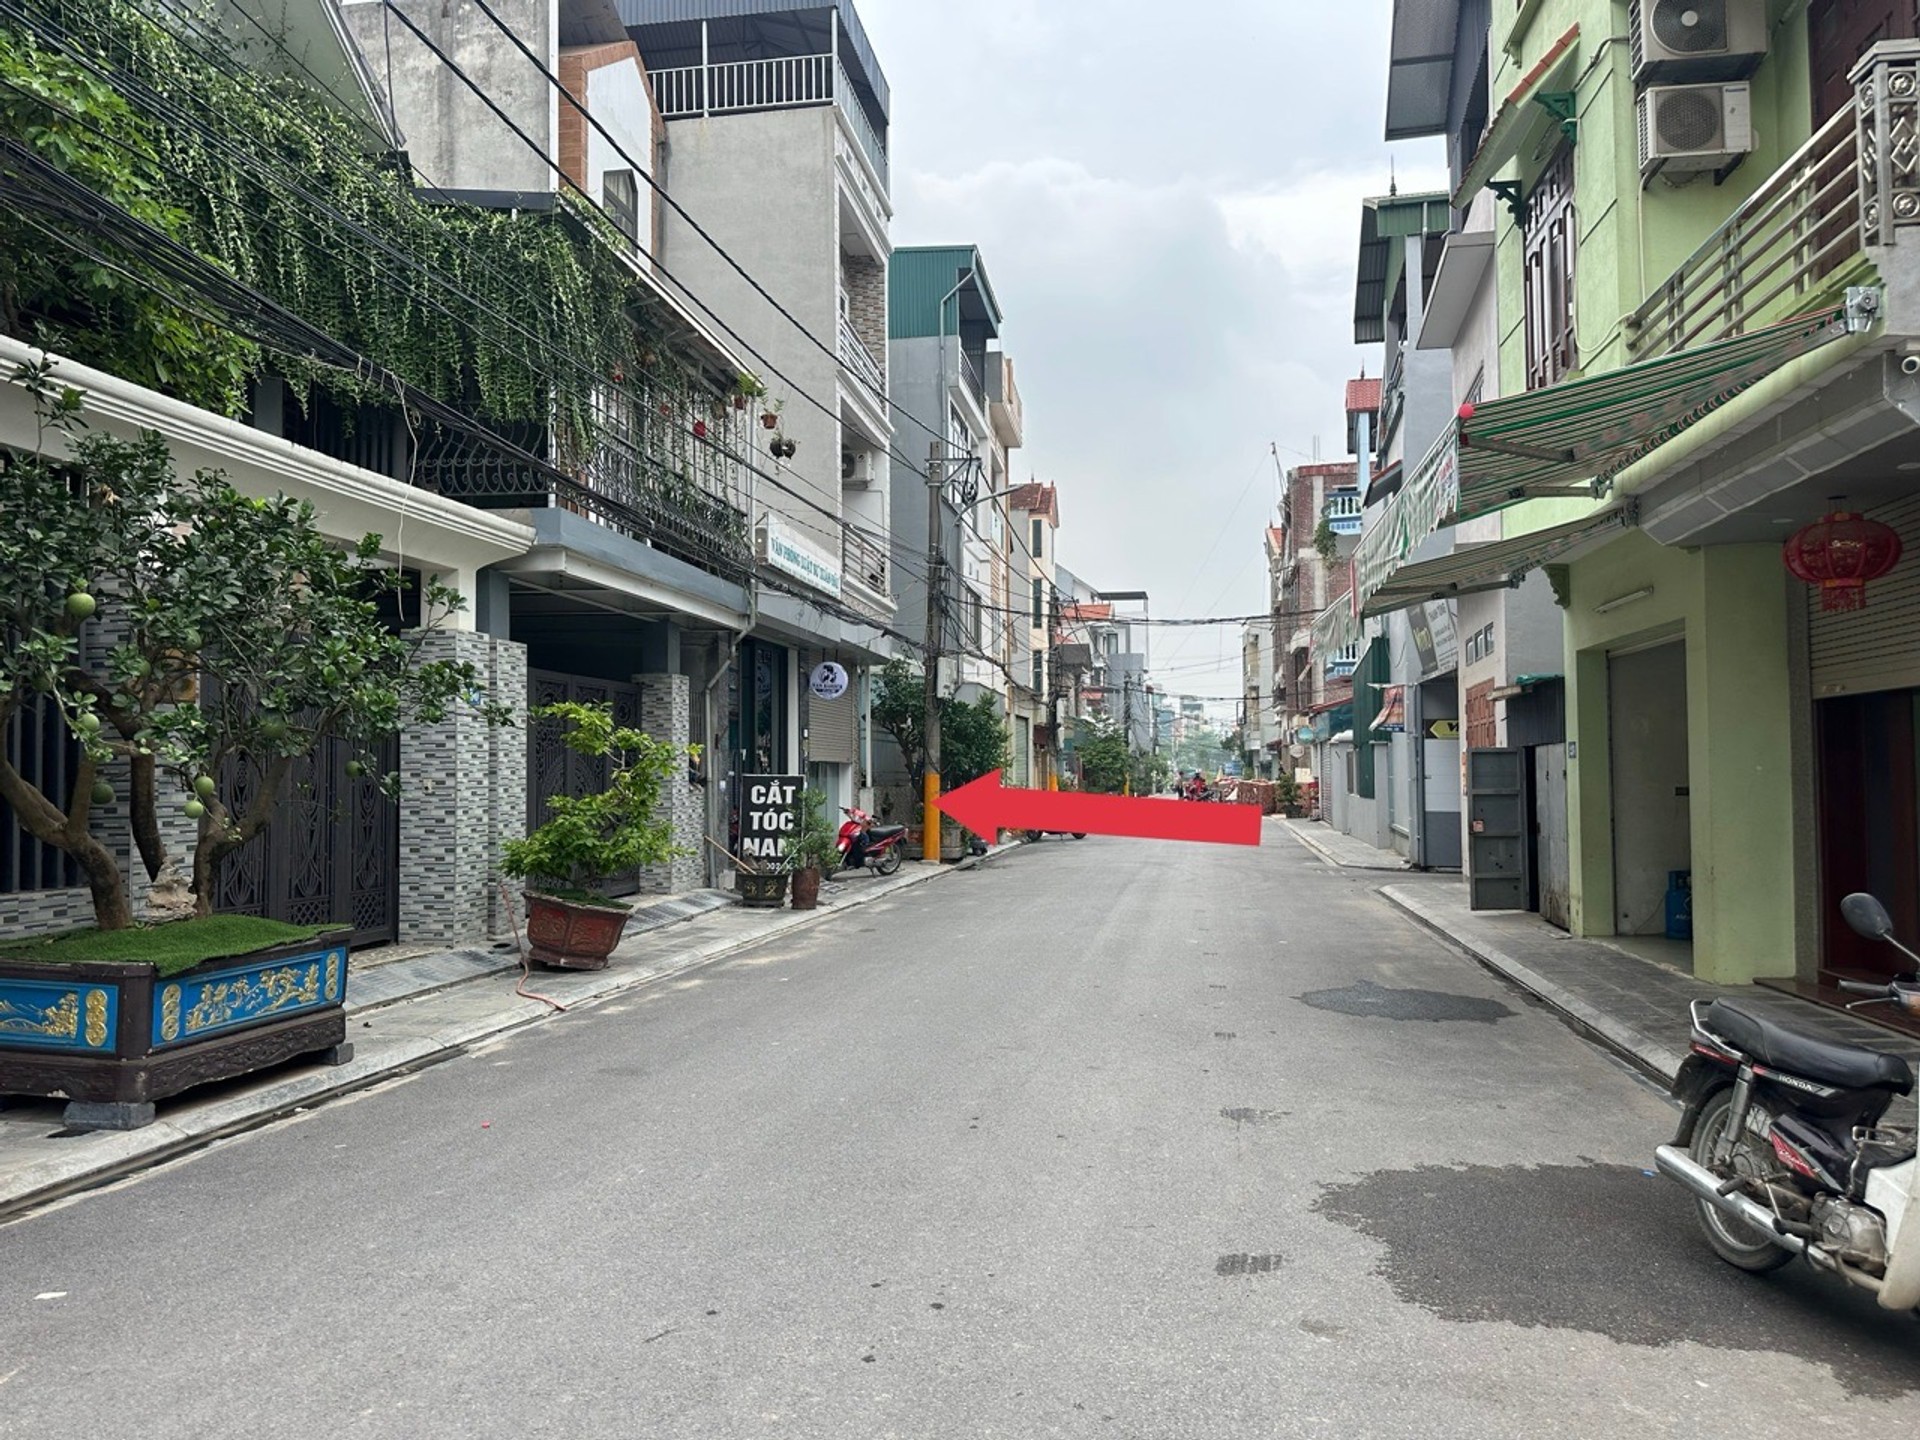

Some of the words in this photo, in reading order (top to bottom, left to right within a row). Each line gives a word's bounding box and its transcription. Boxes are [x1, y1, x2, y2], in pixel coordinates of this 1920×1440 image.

[751, 779, 796, 804] CẮT
[749, 807, 795, 831] TÓC
[1779, 1074, 1813, 1092] HONDA
